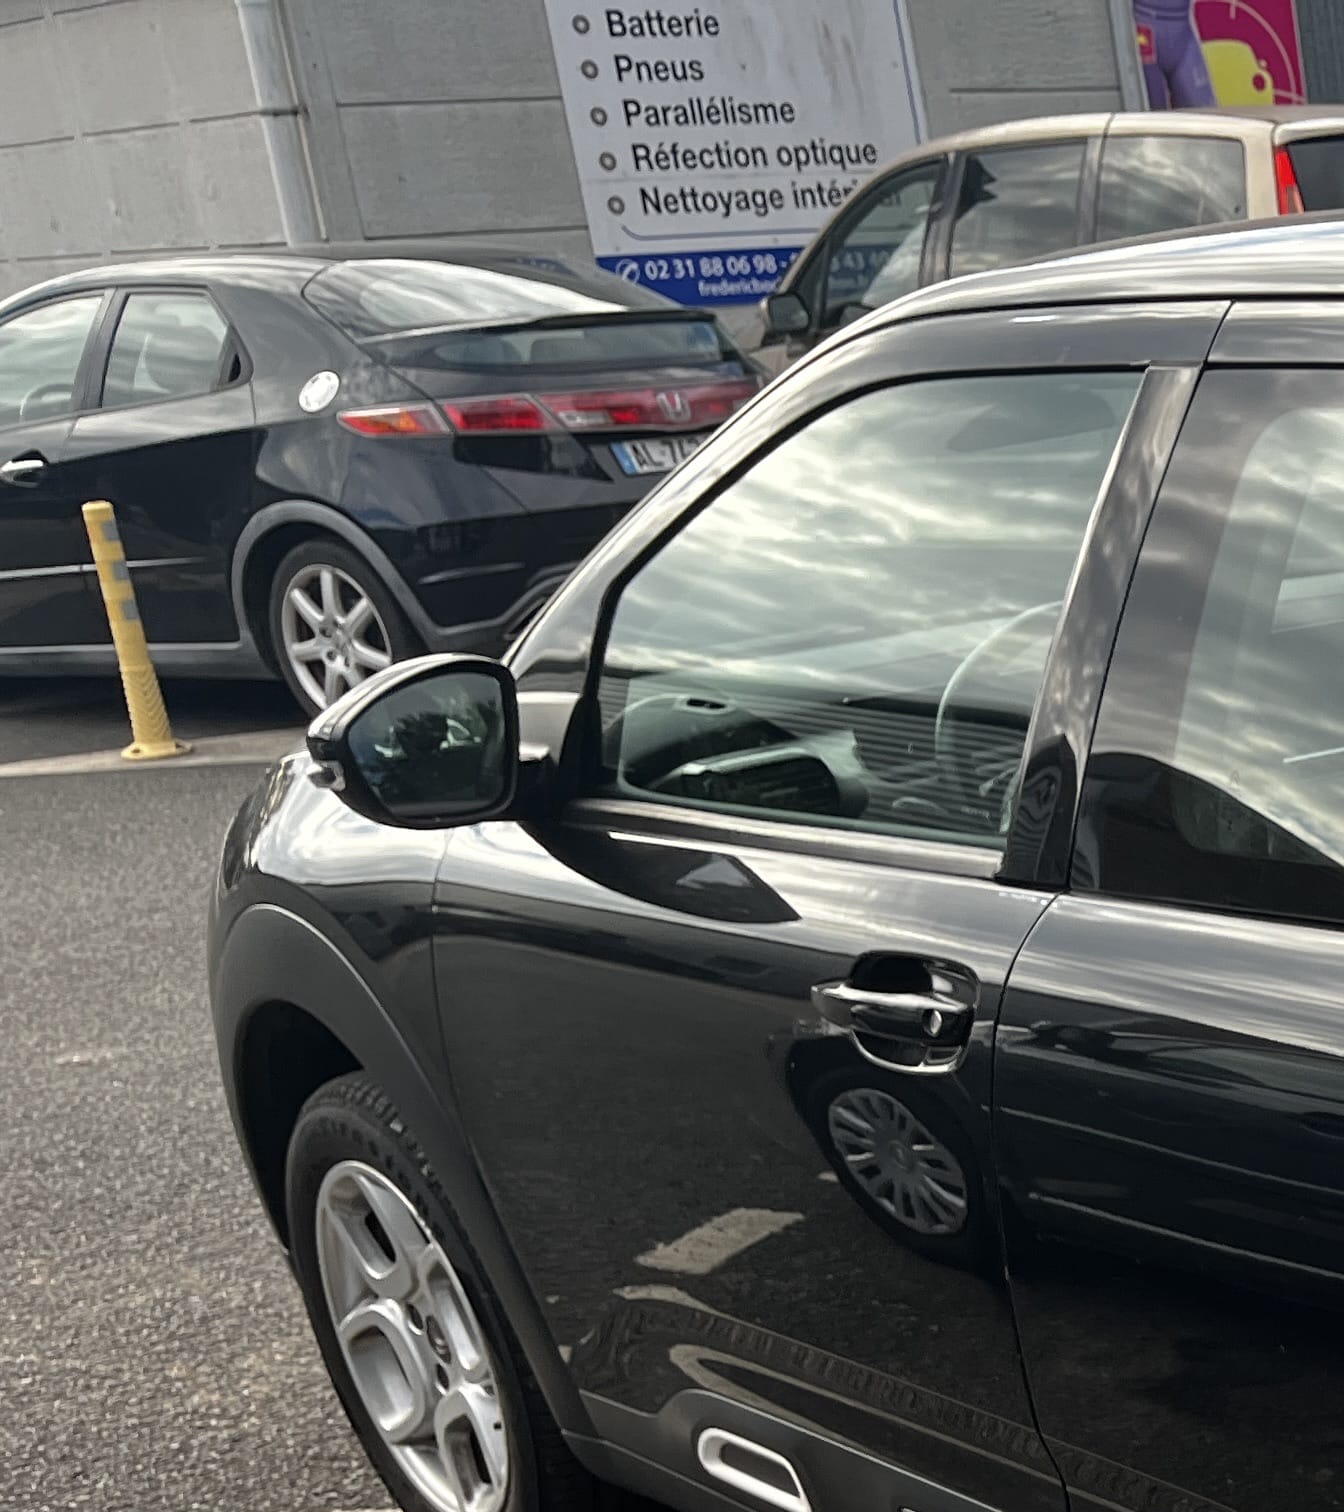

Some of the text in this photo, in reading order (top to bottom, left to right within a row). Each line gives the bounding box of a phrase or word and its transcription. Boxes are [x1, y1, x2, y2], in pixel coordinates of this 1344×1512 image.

[605, 8, 720, 37] Batterie
[614, 54, 704, 82] Pneus
[622, 96, 796, 127] Parallélisme
[632, 138, 877, 172] Réfection optique
[640, 186, 784, 218] Nettoyage
[645, 260, 670, 280] 02
[673, 258, 695, 279] 31
[726, 255, 751, 276] 06
[752, 253, 777, 275] 98
